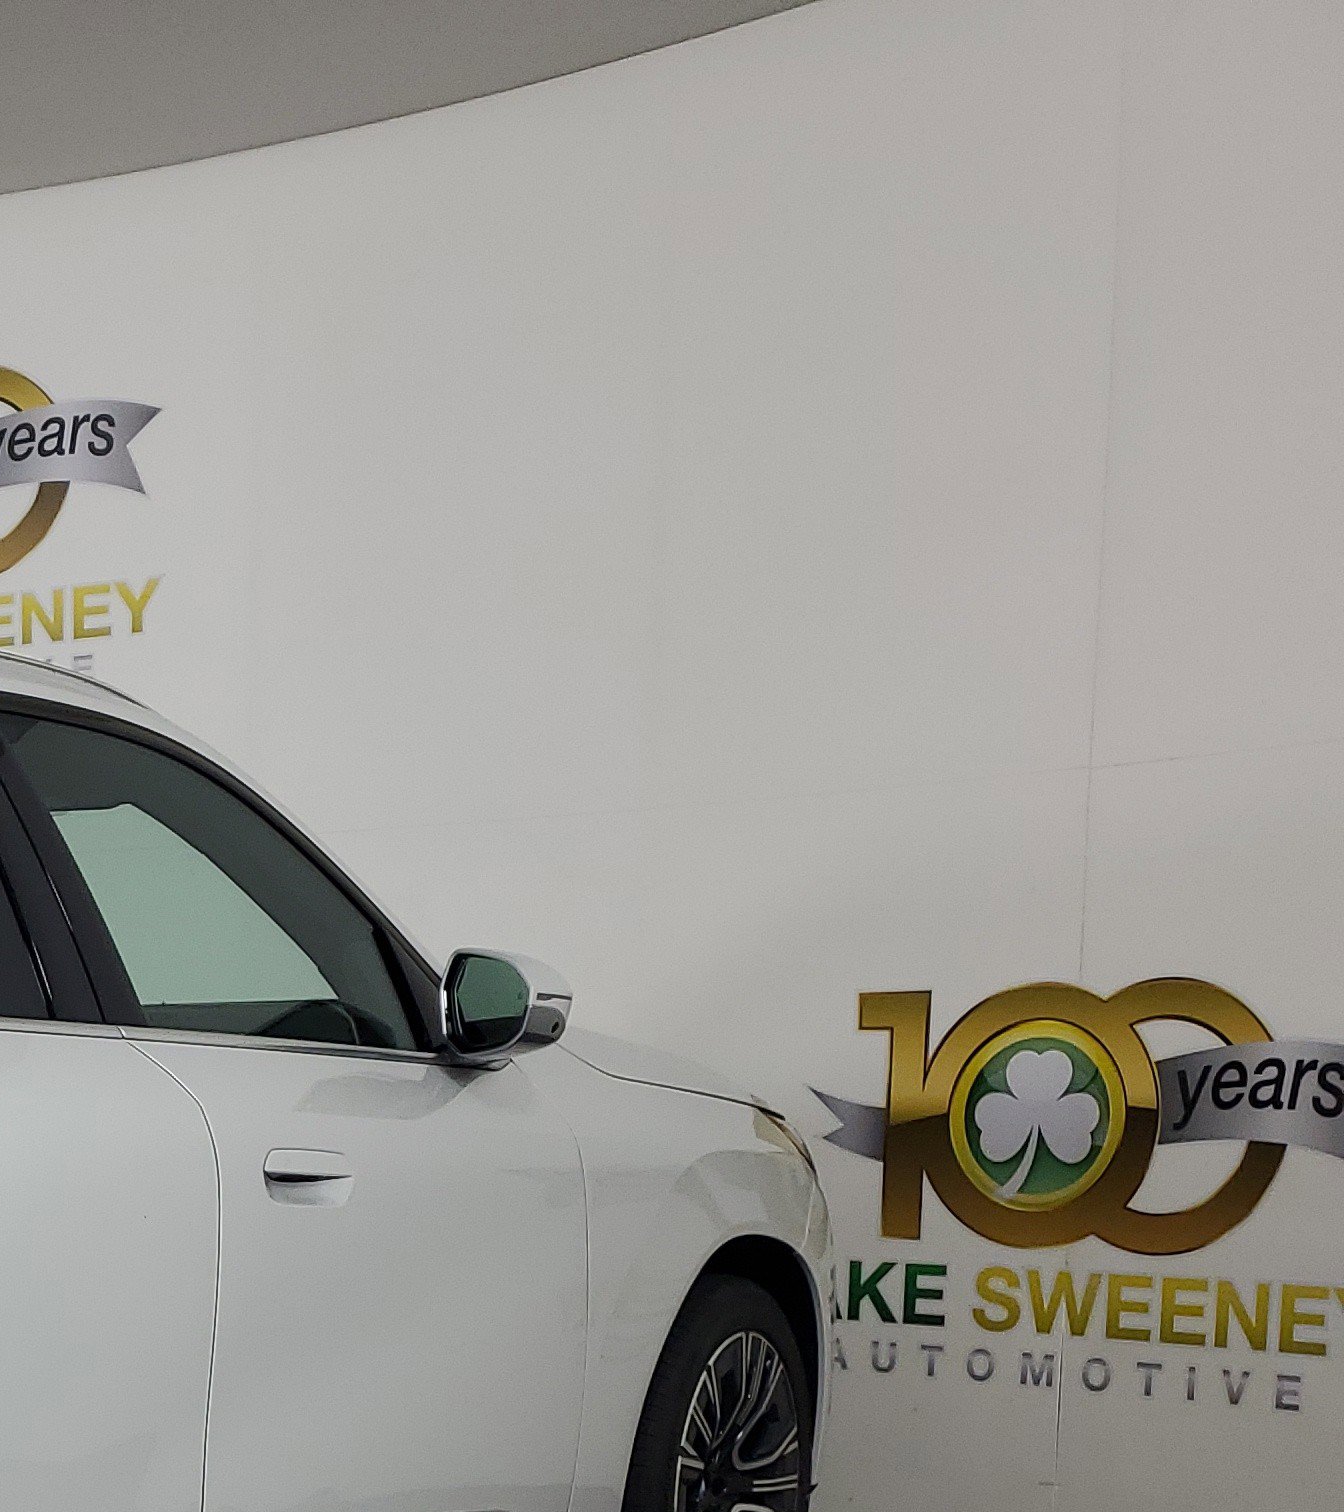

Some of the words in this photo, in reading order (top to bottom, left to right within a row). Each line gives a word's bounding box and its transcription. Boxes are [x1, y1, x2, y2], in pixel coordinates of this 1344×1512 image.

[1173, 1056, 1344, 1130] years
[972, 1266, 1344, 1357] SWEENE
[833, 1337, 1301, 1411] AUTOMOTIVE
